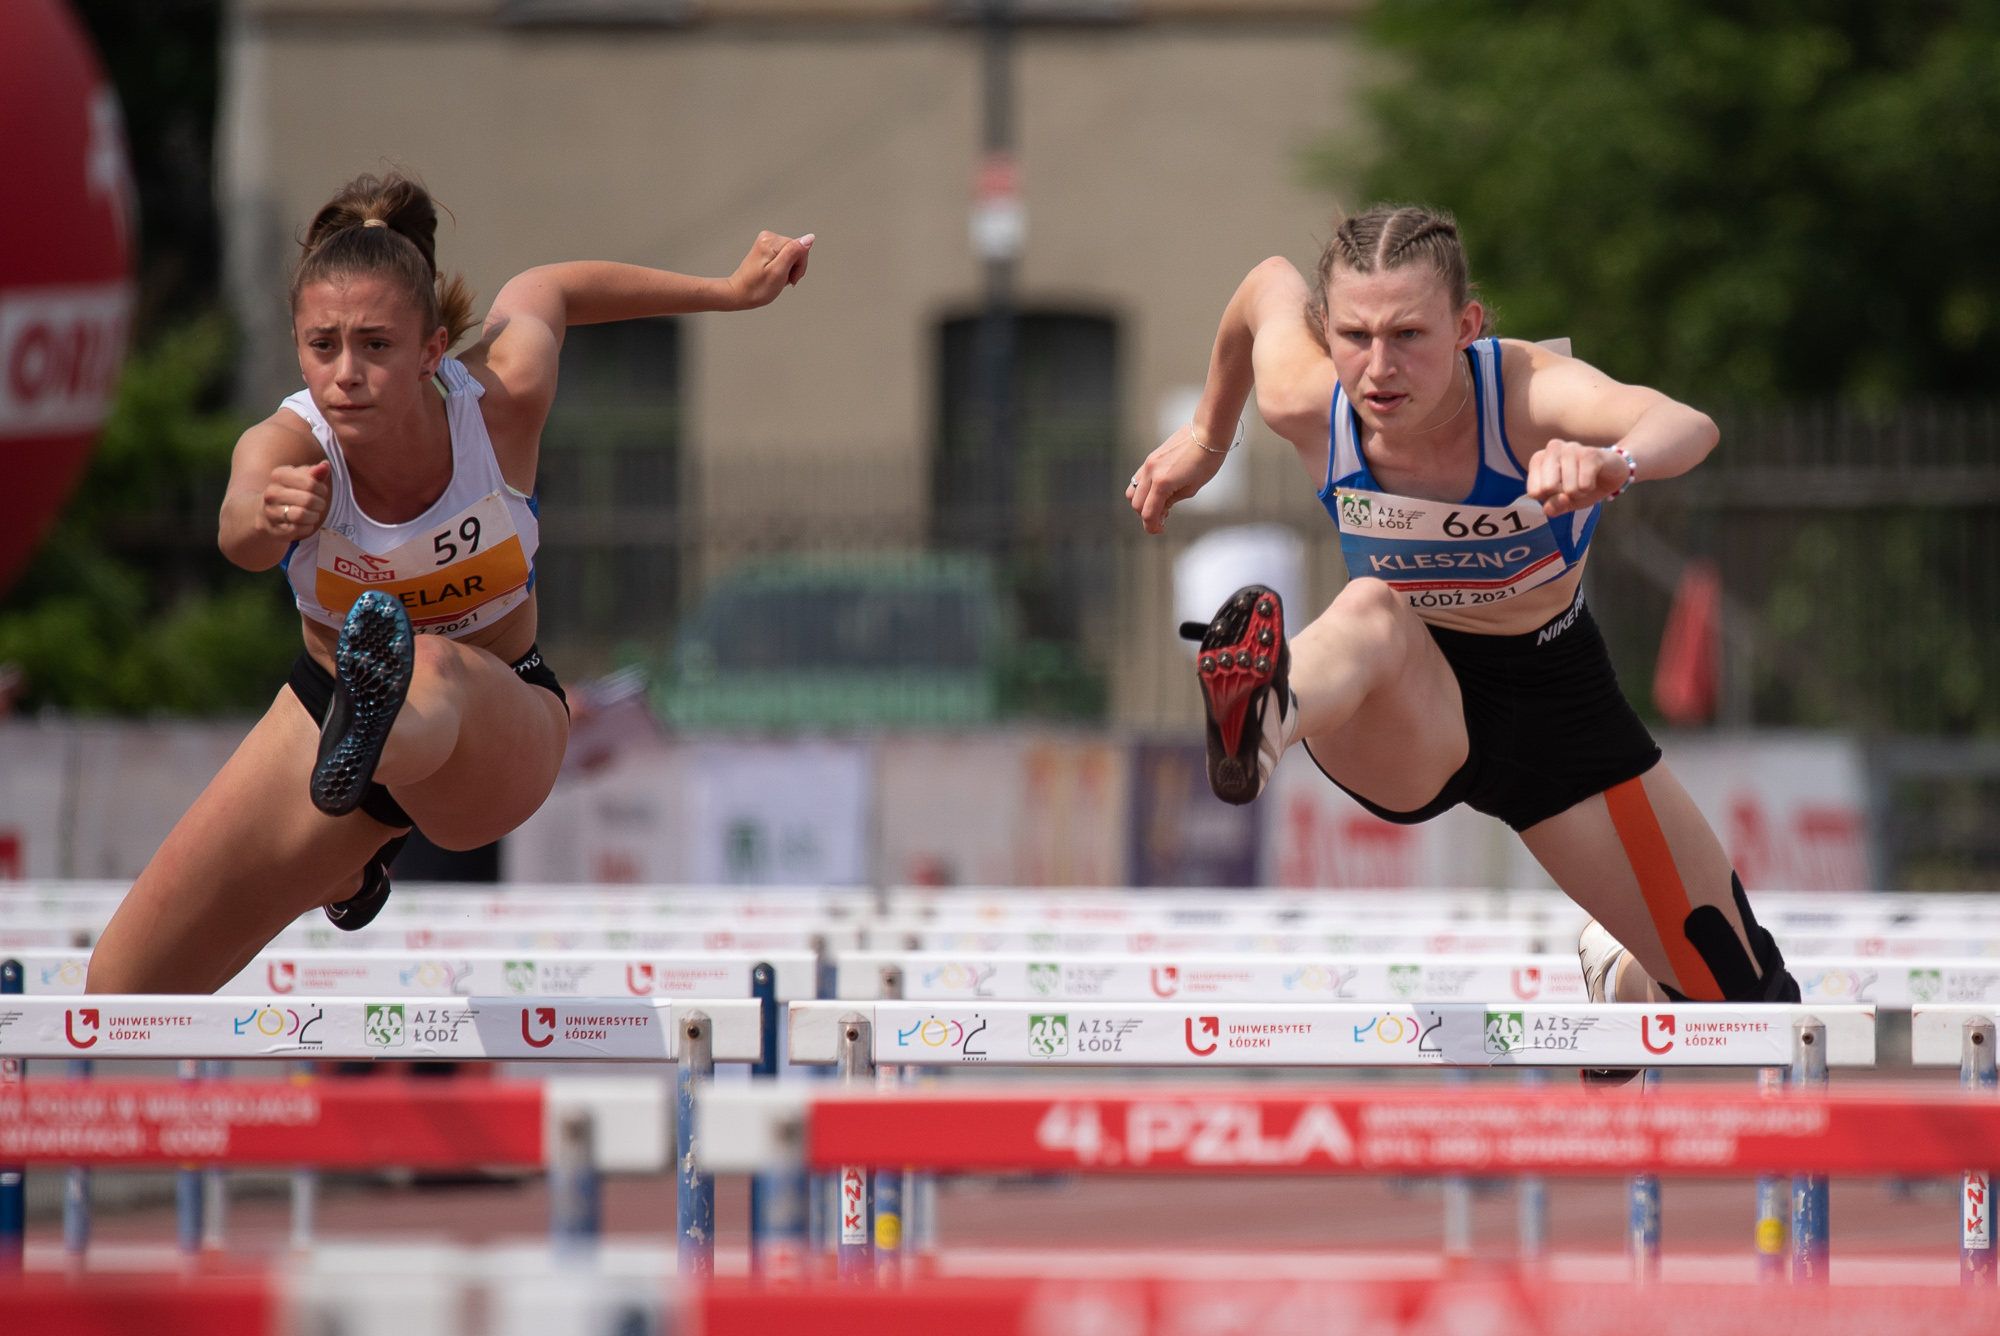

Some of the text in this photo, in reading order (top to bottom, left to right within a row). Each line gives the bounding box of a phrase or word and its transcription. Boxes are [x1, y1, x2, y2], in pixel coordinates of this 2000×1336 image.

[1378, 506, 1405, 518] AZS
[1442, 510, 1531, 538] 661
[433, 516, 482, 566] 59
[1369, 545, 1531, 572] KLESZNO
[337, 560, 392, 581] ORLEN
[1409, 586, 1517, 608] ŁÓDŹ 2021
[434, 612, 479, 636] 2021
[1536, 607, 1575, 647] NIKE
[109, 1016, 192, 1027] UNIWERSYTET
[414, 1010, 451, 1023] AZS
[565, 1016, 649, 1026] UNIWERSYTET
[1078, 1020, 1114, 1033] AZS
[1229, 1024, 1312, 1034] UNIWERSYTET
[1533, 1018, 1570, 1031] AZS
[1685, 1023, 1768, 1033] UNIWERSYTET
[108, 1028, 151, 1040] ŁÓDZKI
[564, 1028, 607, 1040] ŁÓDZKI
[1228, 1036, 1271, 1048] ŁÓDZKI
[1684, 1035, 1727, 1047] ŁÓDZKI
[1126, 1101, 1354, 1166] PZLA
